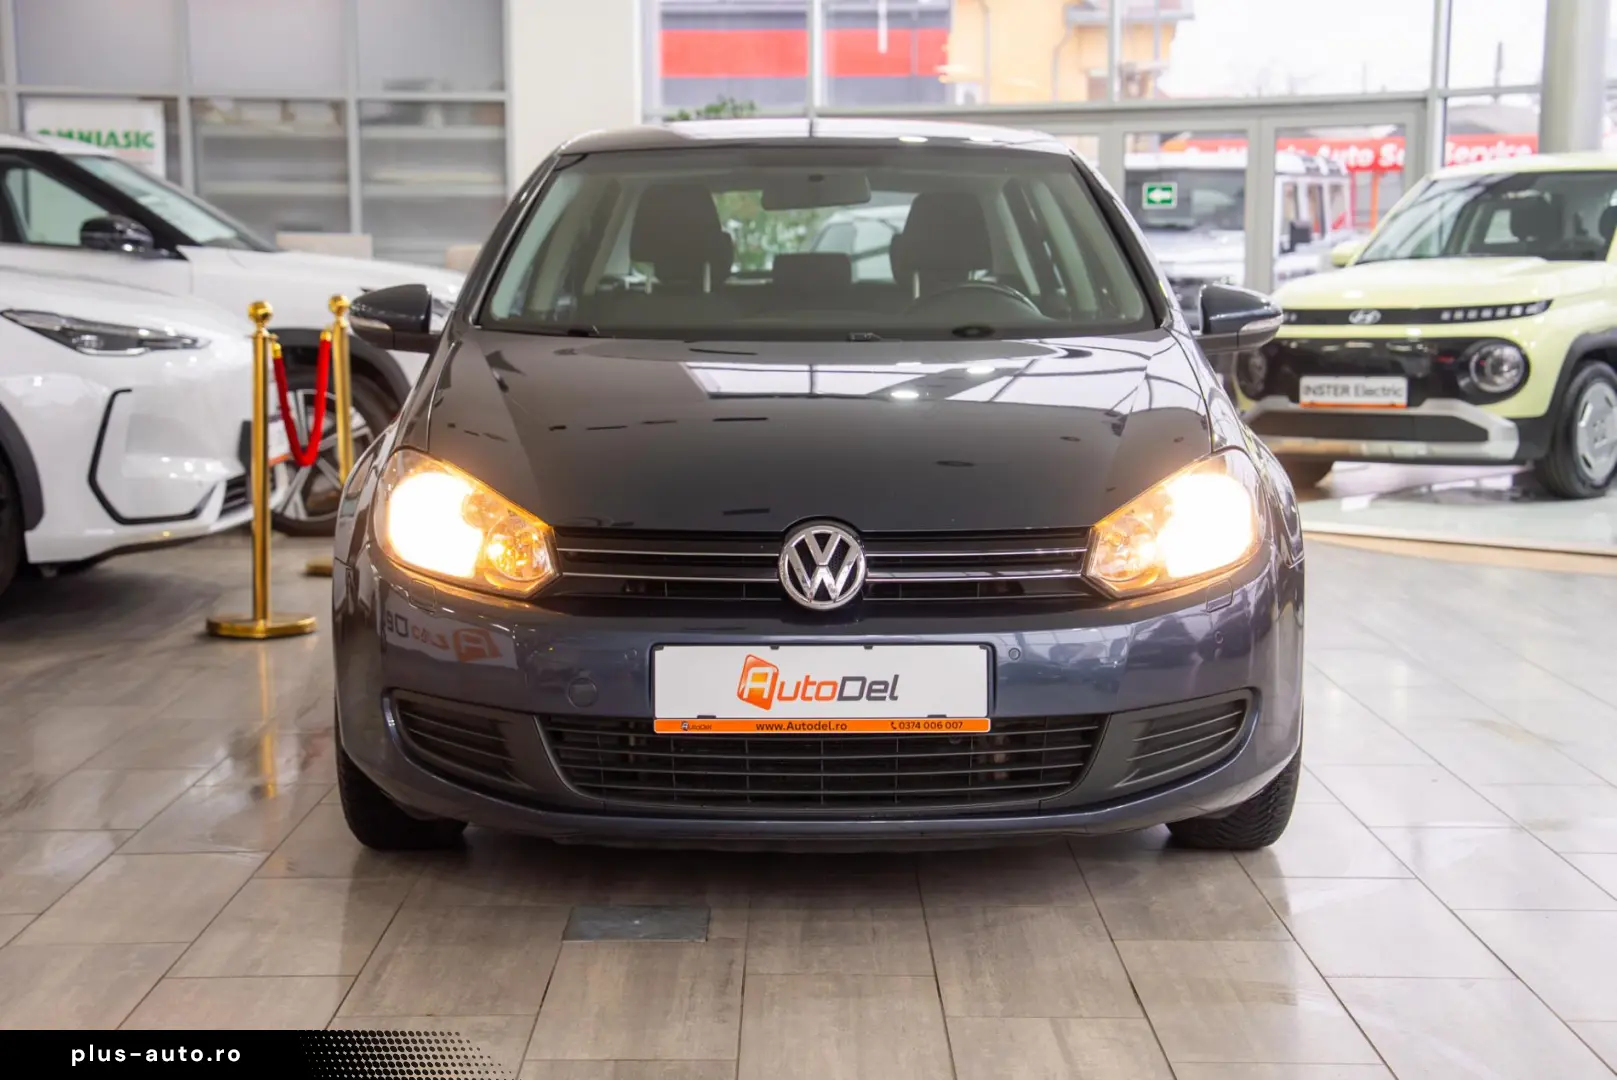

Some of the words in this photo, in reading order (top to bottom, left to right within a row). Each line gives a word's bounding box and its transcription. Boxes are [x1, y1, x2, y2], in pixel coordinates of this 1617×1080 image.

[740, 663, 899, 704] AutoDel
[755, 721, 848, 731] www.Autodel.ro
[899, 721, 921, 730] 0374
[923, 721, 943, 730] 006
[945, 721, 964, 730] 007
